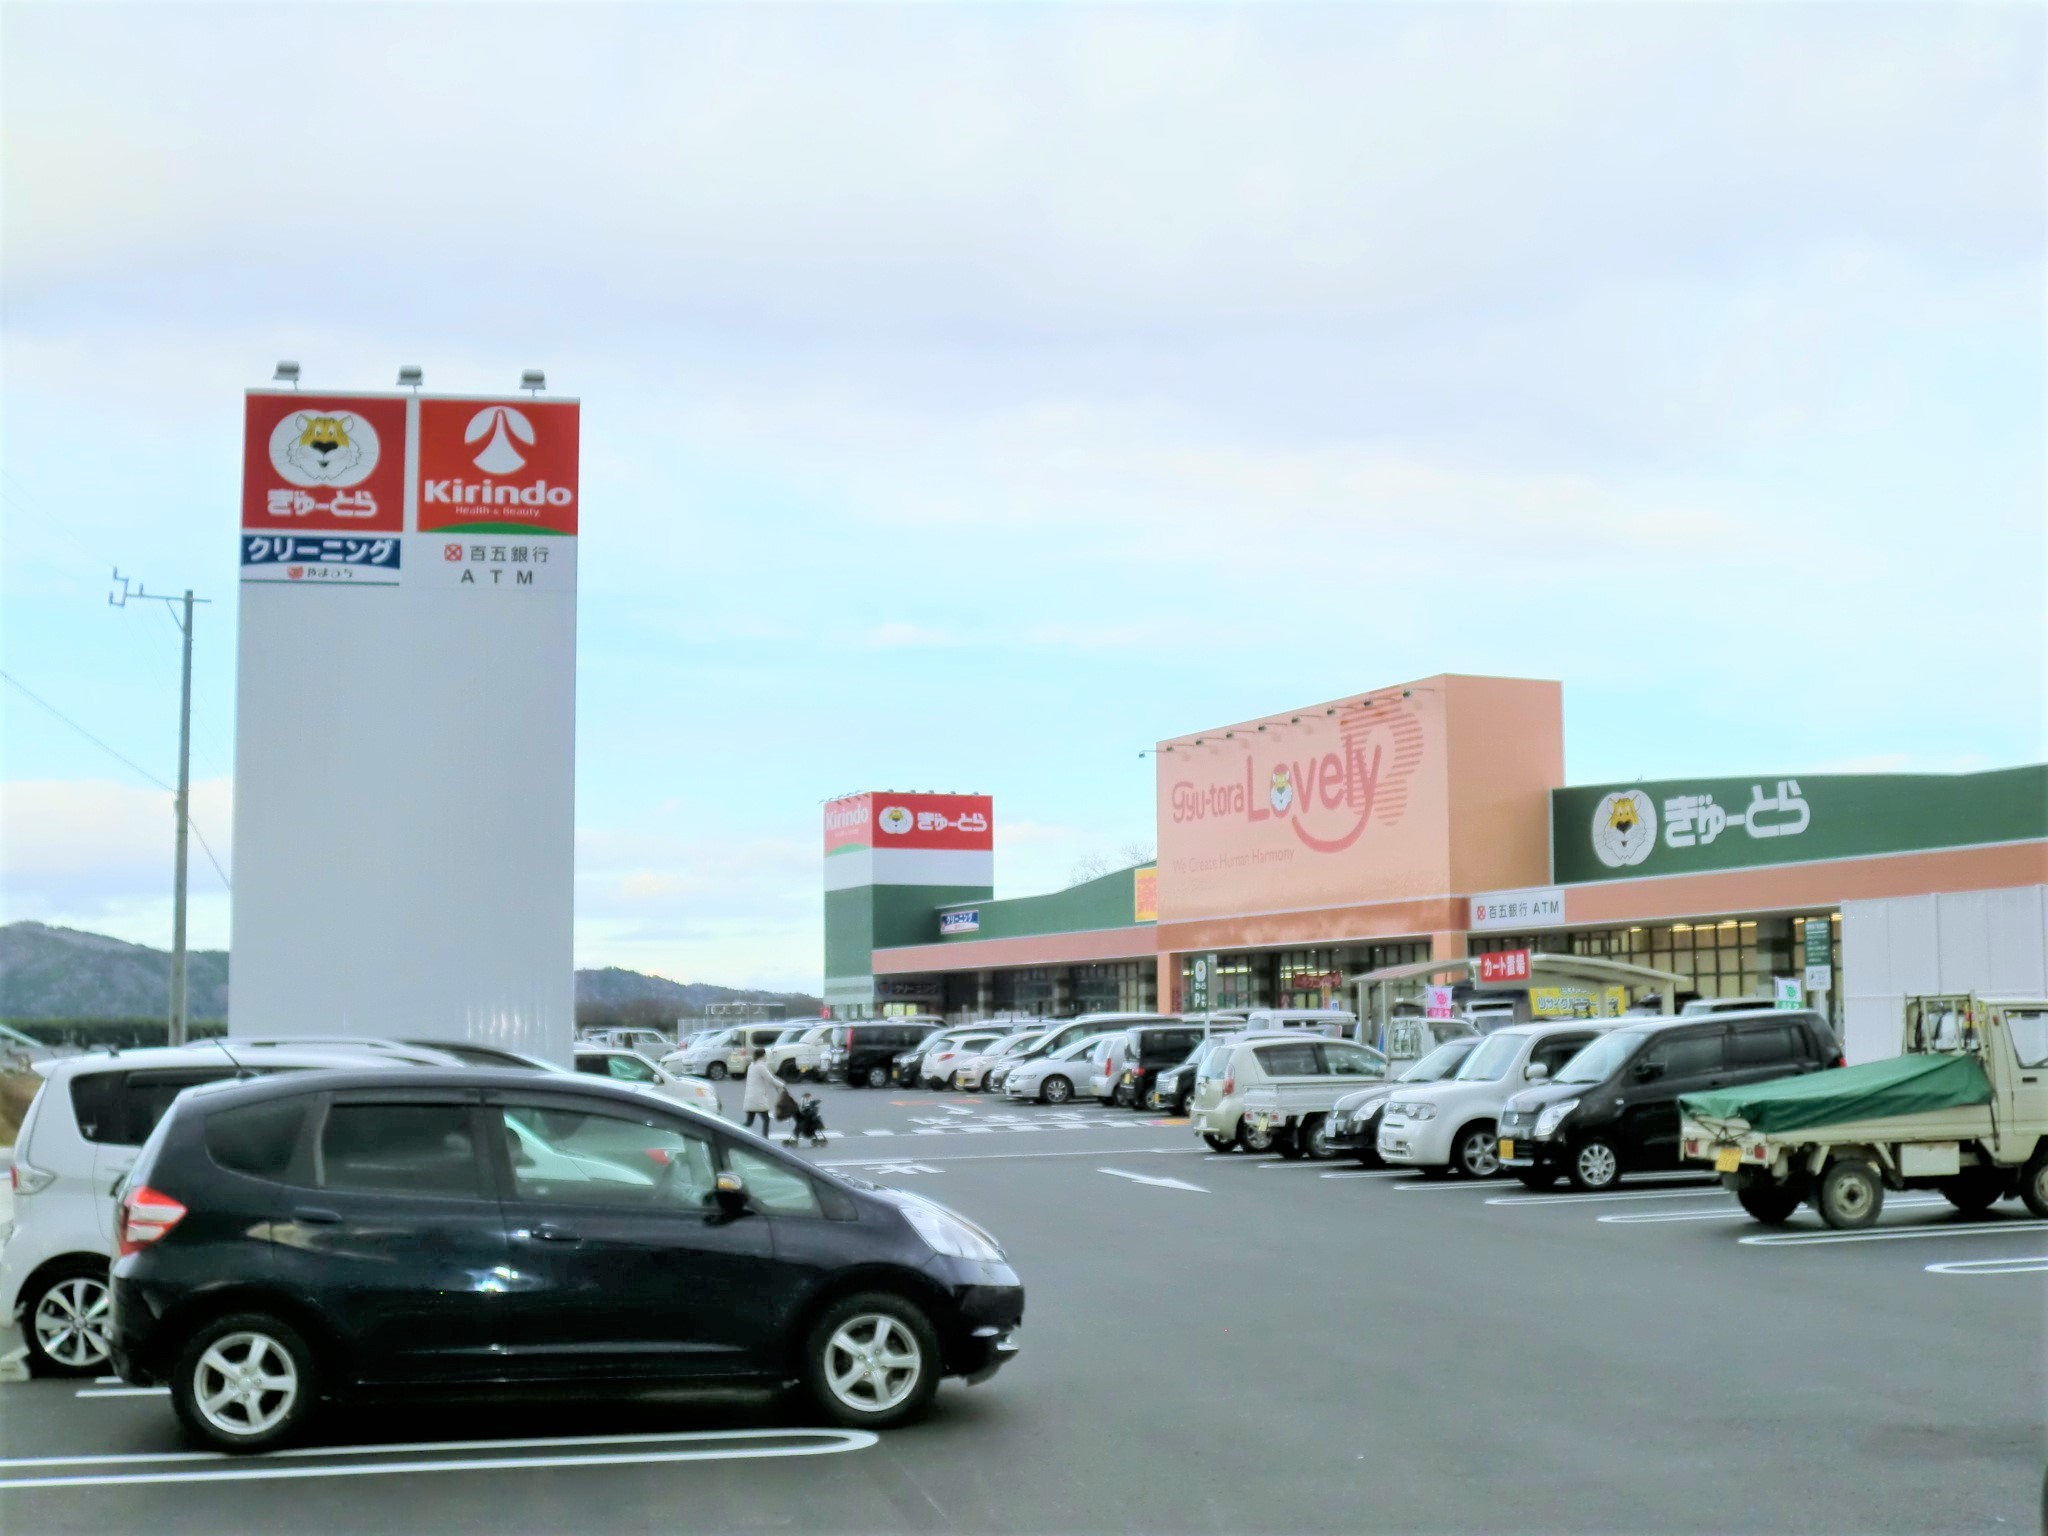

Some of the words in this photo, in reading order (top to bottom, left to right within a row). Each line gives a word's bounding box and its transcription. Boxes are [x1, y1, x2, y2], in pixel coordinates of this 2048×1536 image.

[266, 488, 378, 517] ぎゅーとら
[424, 478, 573, 506] Kirindo
[455, 506, 490, 515] Health
[503, 507, 540, 517] Beauty
[248, 537, 393, 564] クリーニング
[470, 546, 549, 563] 百五銀行
[1247, 734, 1382, 854] Lovely
[826, 805, 869, 830] Kirindo
[917, 812, 988, 832] ぎゅーとら
[1664, 780, 1811, 848] ぎゅーとら
[946, 912, 973, 925] クリーニング
[1488, 902, 1528, 920] 百五銀行
[1532, 899, 1560, 916] ATM
[1485, 953, 1526, 977] カート置場
